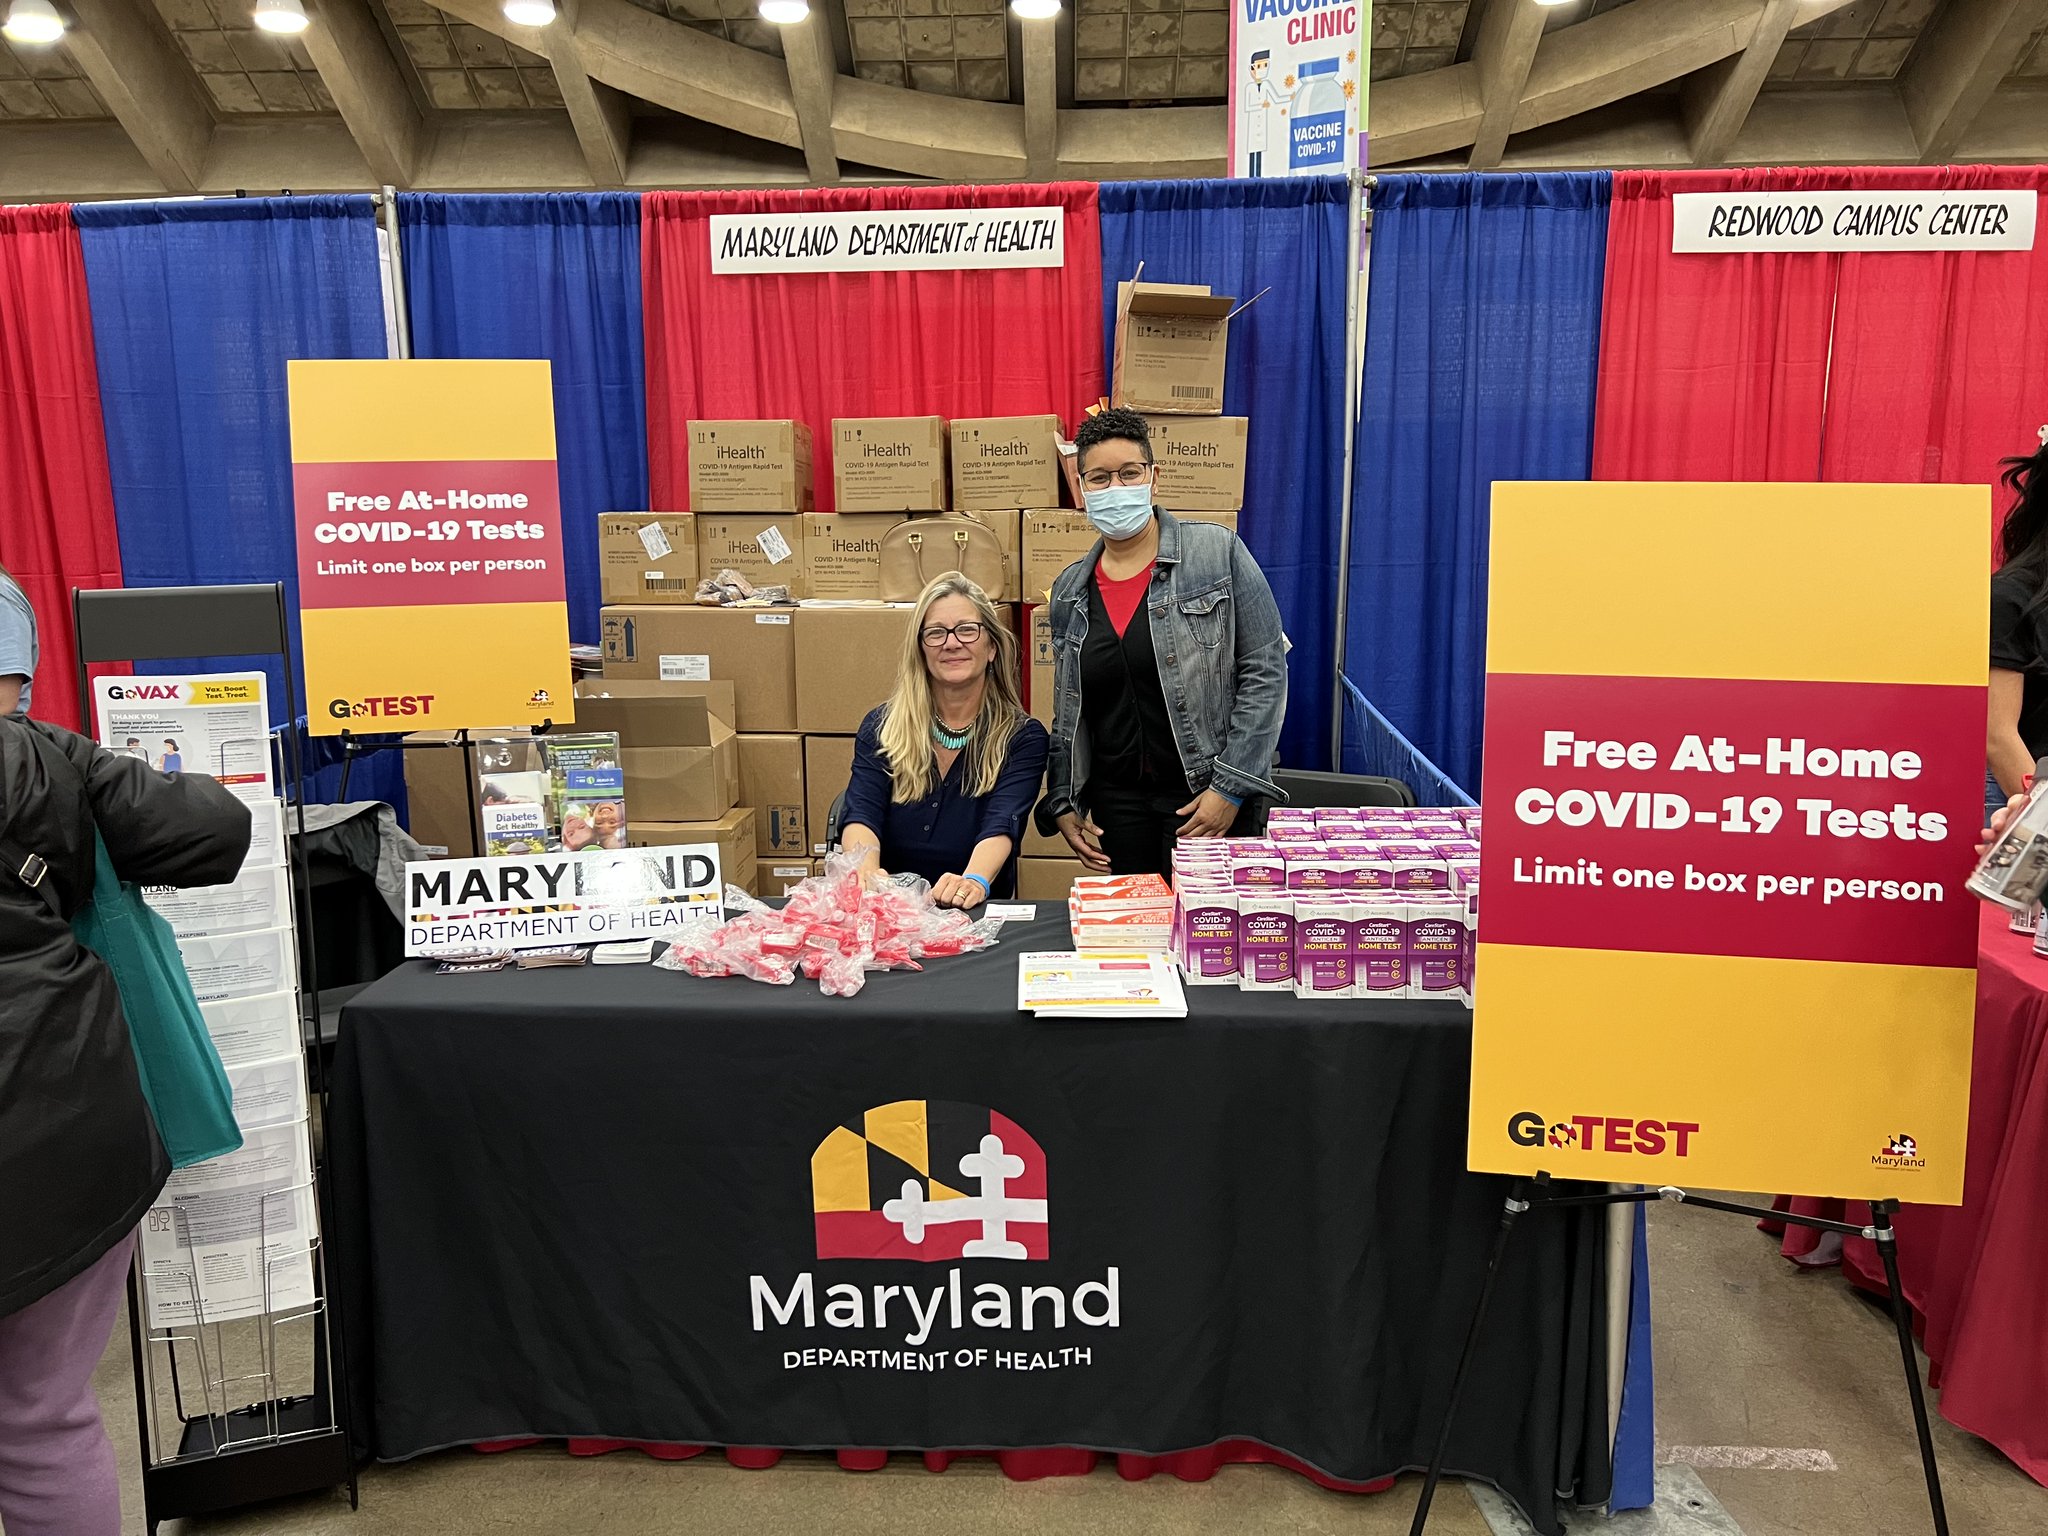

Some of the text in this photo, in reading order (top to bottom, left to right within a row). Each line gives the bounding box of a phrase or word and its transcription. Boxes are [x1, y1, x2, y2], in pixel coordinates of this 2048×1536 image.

[1287, 6, 1356, 45] CLINIC
[1293, 121, 1341, 142] VACCINE
[1298, 140, 1337, 157] COVID-19
[1709, 203, 2009, 237] REDWOOD CAMPUS CENTER
[720, 219, 1056, 259] MARYLAND DEPARTMENT of HEALTH
[717, 446, 765, 459] iHealth
[863, 443, 911, 457] iHealth
[980, 443, 1028, 457] iHealth
[1167, 442, 1216, 456] iHealth
[729, 463, 751, 471] Antigen
[327, 490, 528, 511] Free At-Home
[314, 520, 545, 544] COVID-19 Tests
[832, 539, 879, 552] iHealth
[317, 558, 546, 575] Limit one box per person
[108, 685, 179, 700] GoVAX
[329, 695, 435, 719] GoTEST
[1543, 730, 1922, 779] Free At-Home
[496, 813, 537, 822] Diabetes
[1515, 788, 1948, 841] COVID-19 Tests
[511, 822, 538, 830] Healthy
[1513, 857, 1944, 904] Limit one box per person
[411, 916, 579, 946] DEPARTMENT
[589, 913, 620, 934] OF
[1305, 928, 1345, 936] COVID-19
[1507, 1111, 1699, 1157] GoTEST
[1872, 1156, 1925, 1167] Maryland
[750, 1266, 1120, 1346] Maryland
[783, 1346, 1092, 1372] DEPARTMENT OF HEALTH
